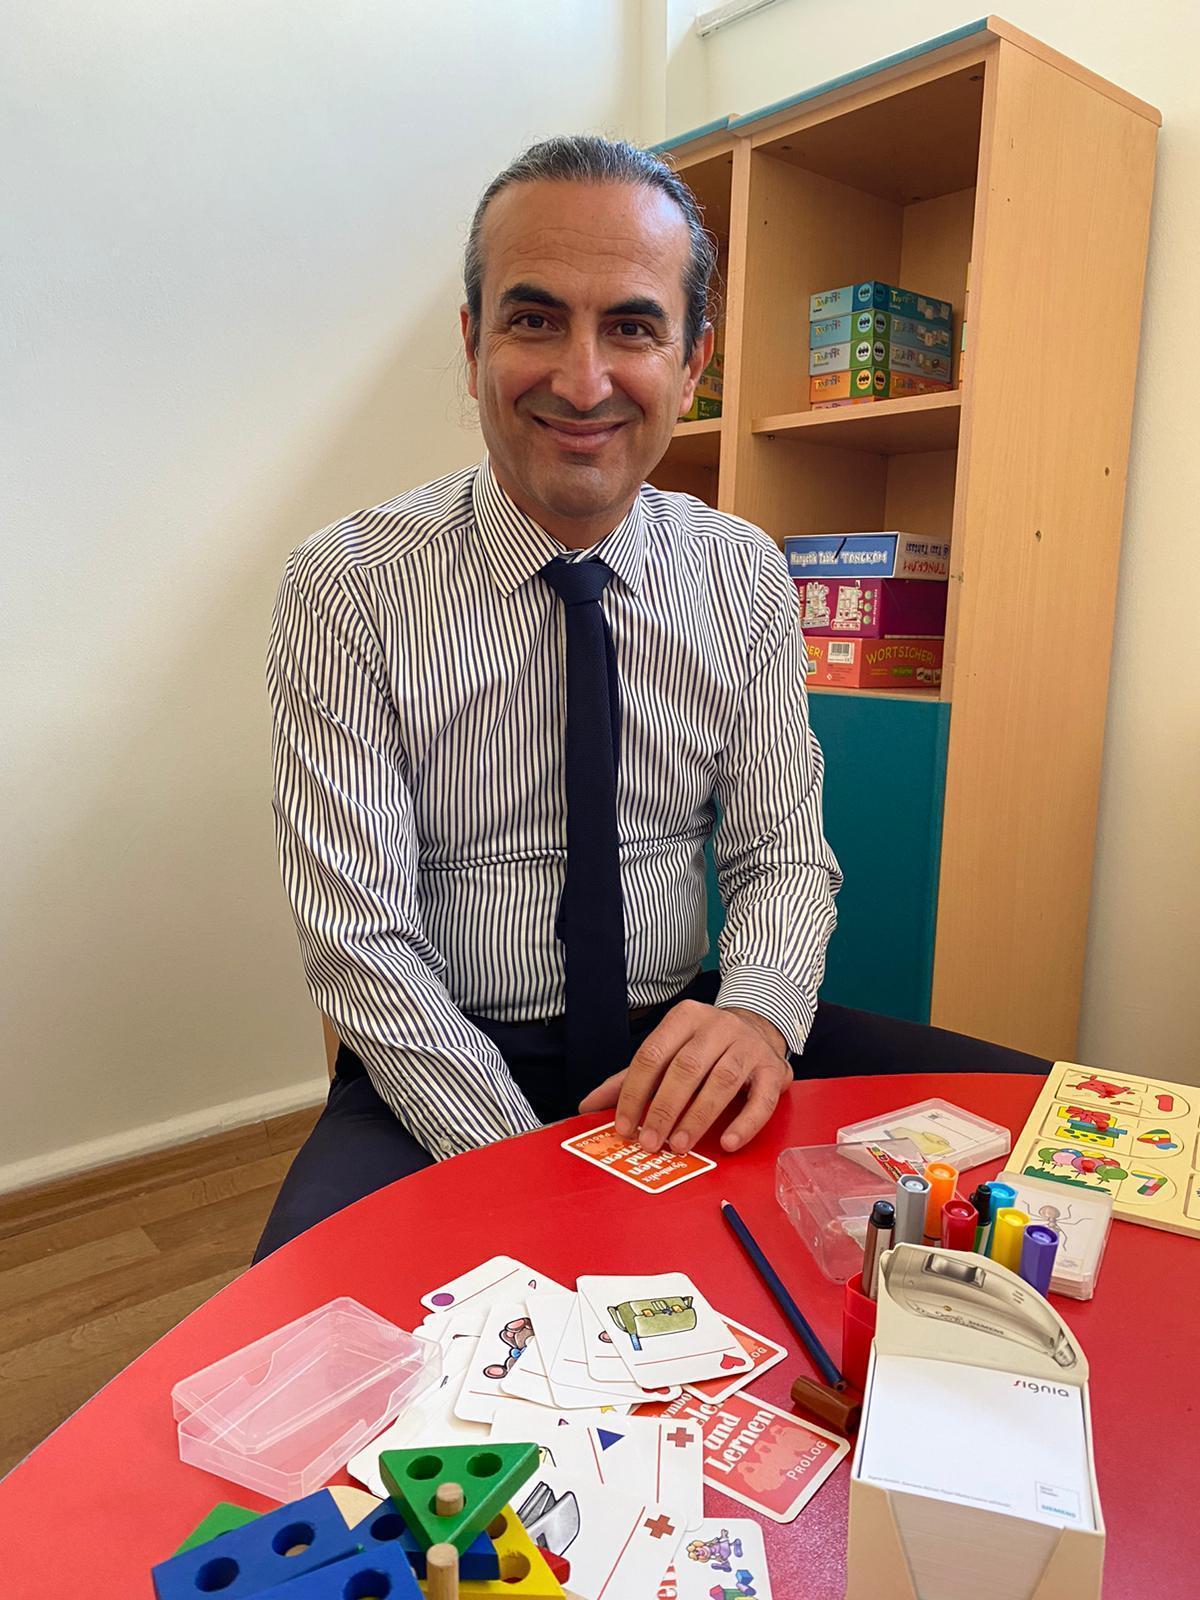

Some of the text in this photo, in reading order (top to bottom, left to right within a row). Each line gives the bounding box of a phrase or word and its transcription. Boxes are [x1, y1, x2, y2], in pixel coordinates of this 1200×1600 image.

[600, 1143, 643, 1166] ernen
[1012, 1379, 1070, 1398] signia
[704, 1411, 741, 1451] und
[704, 1409, 776, 1475] Lernen
